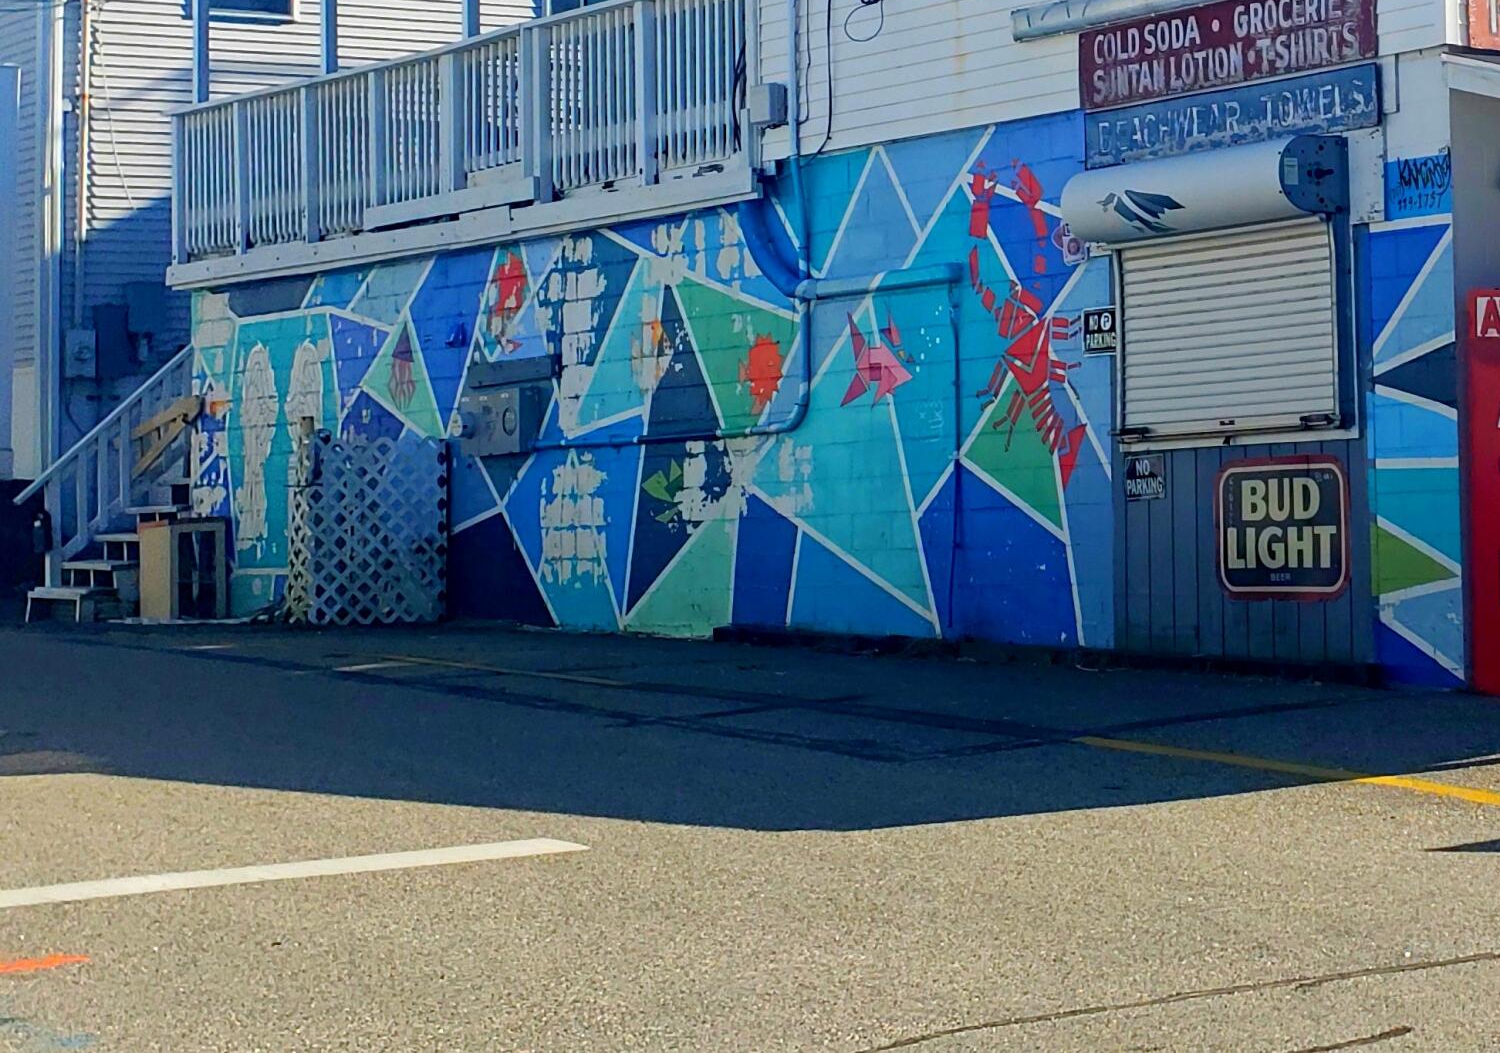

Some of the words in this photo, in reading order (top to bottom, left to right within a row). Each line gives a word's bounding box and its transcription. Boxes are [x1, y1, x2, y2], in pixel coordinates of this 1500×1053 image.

[1093, 59, 1165, 100] SUNTAN
[1170, 42, 1243, 89] LOTION
[1255, 21, 1359, 74] T-SHIRTS
[1094, 27, 1140, 65] COLD
[1144, 15, 1201, 55] SODA
[1127, 477, 1163, 495] PARKING
[1135, 459, 1150, 476] NO
[1241, 477, 1320, 521] BUD
[1227, 525, 1337, 569] LIGHT
